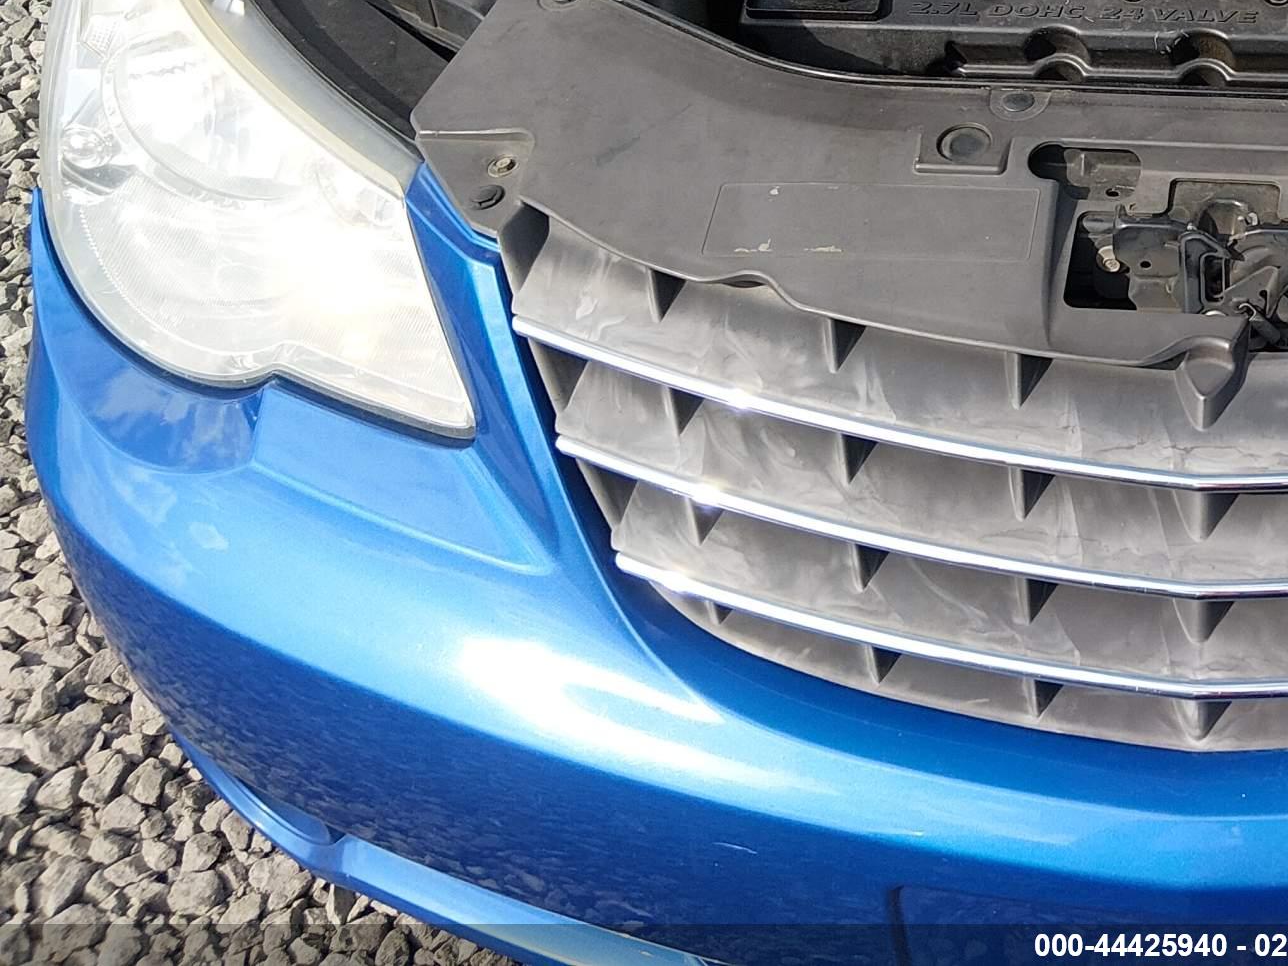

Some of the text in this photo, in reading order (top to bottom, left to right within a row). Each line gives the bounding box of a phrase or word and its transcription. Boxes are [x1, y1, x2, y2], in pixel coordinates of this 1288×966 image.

[908, 1, 1260, 24] 2.7L DOHC 24 VALVE
